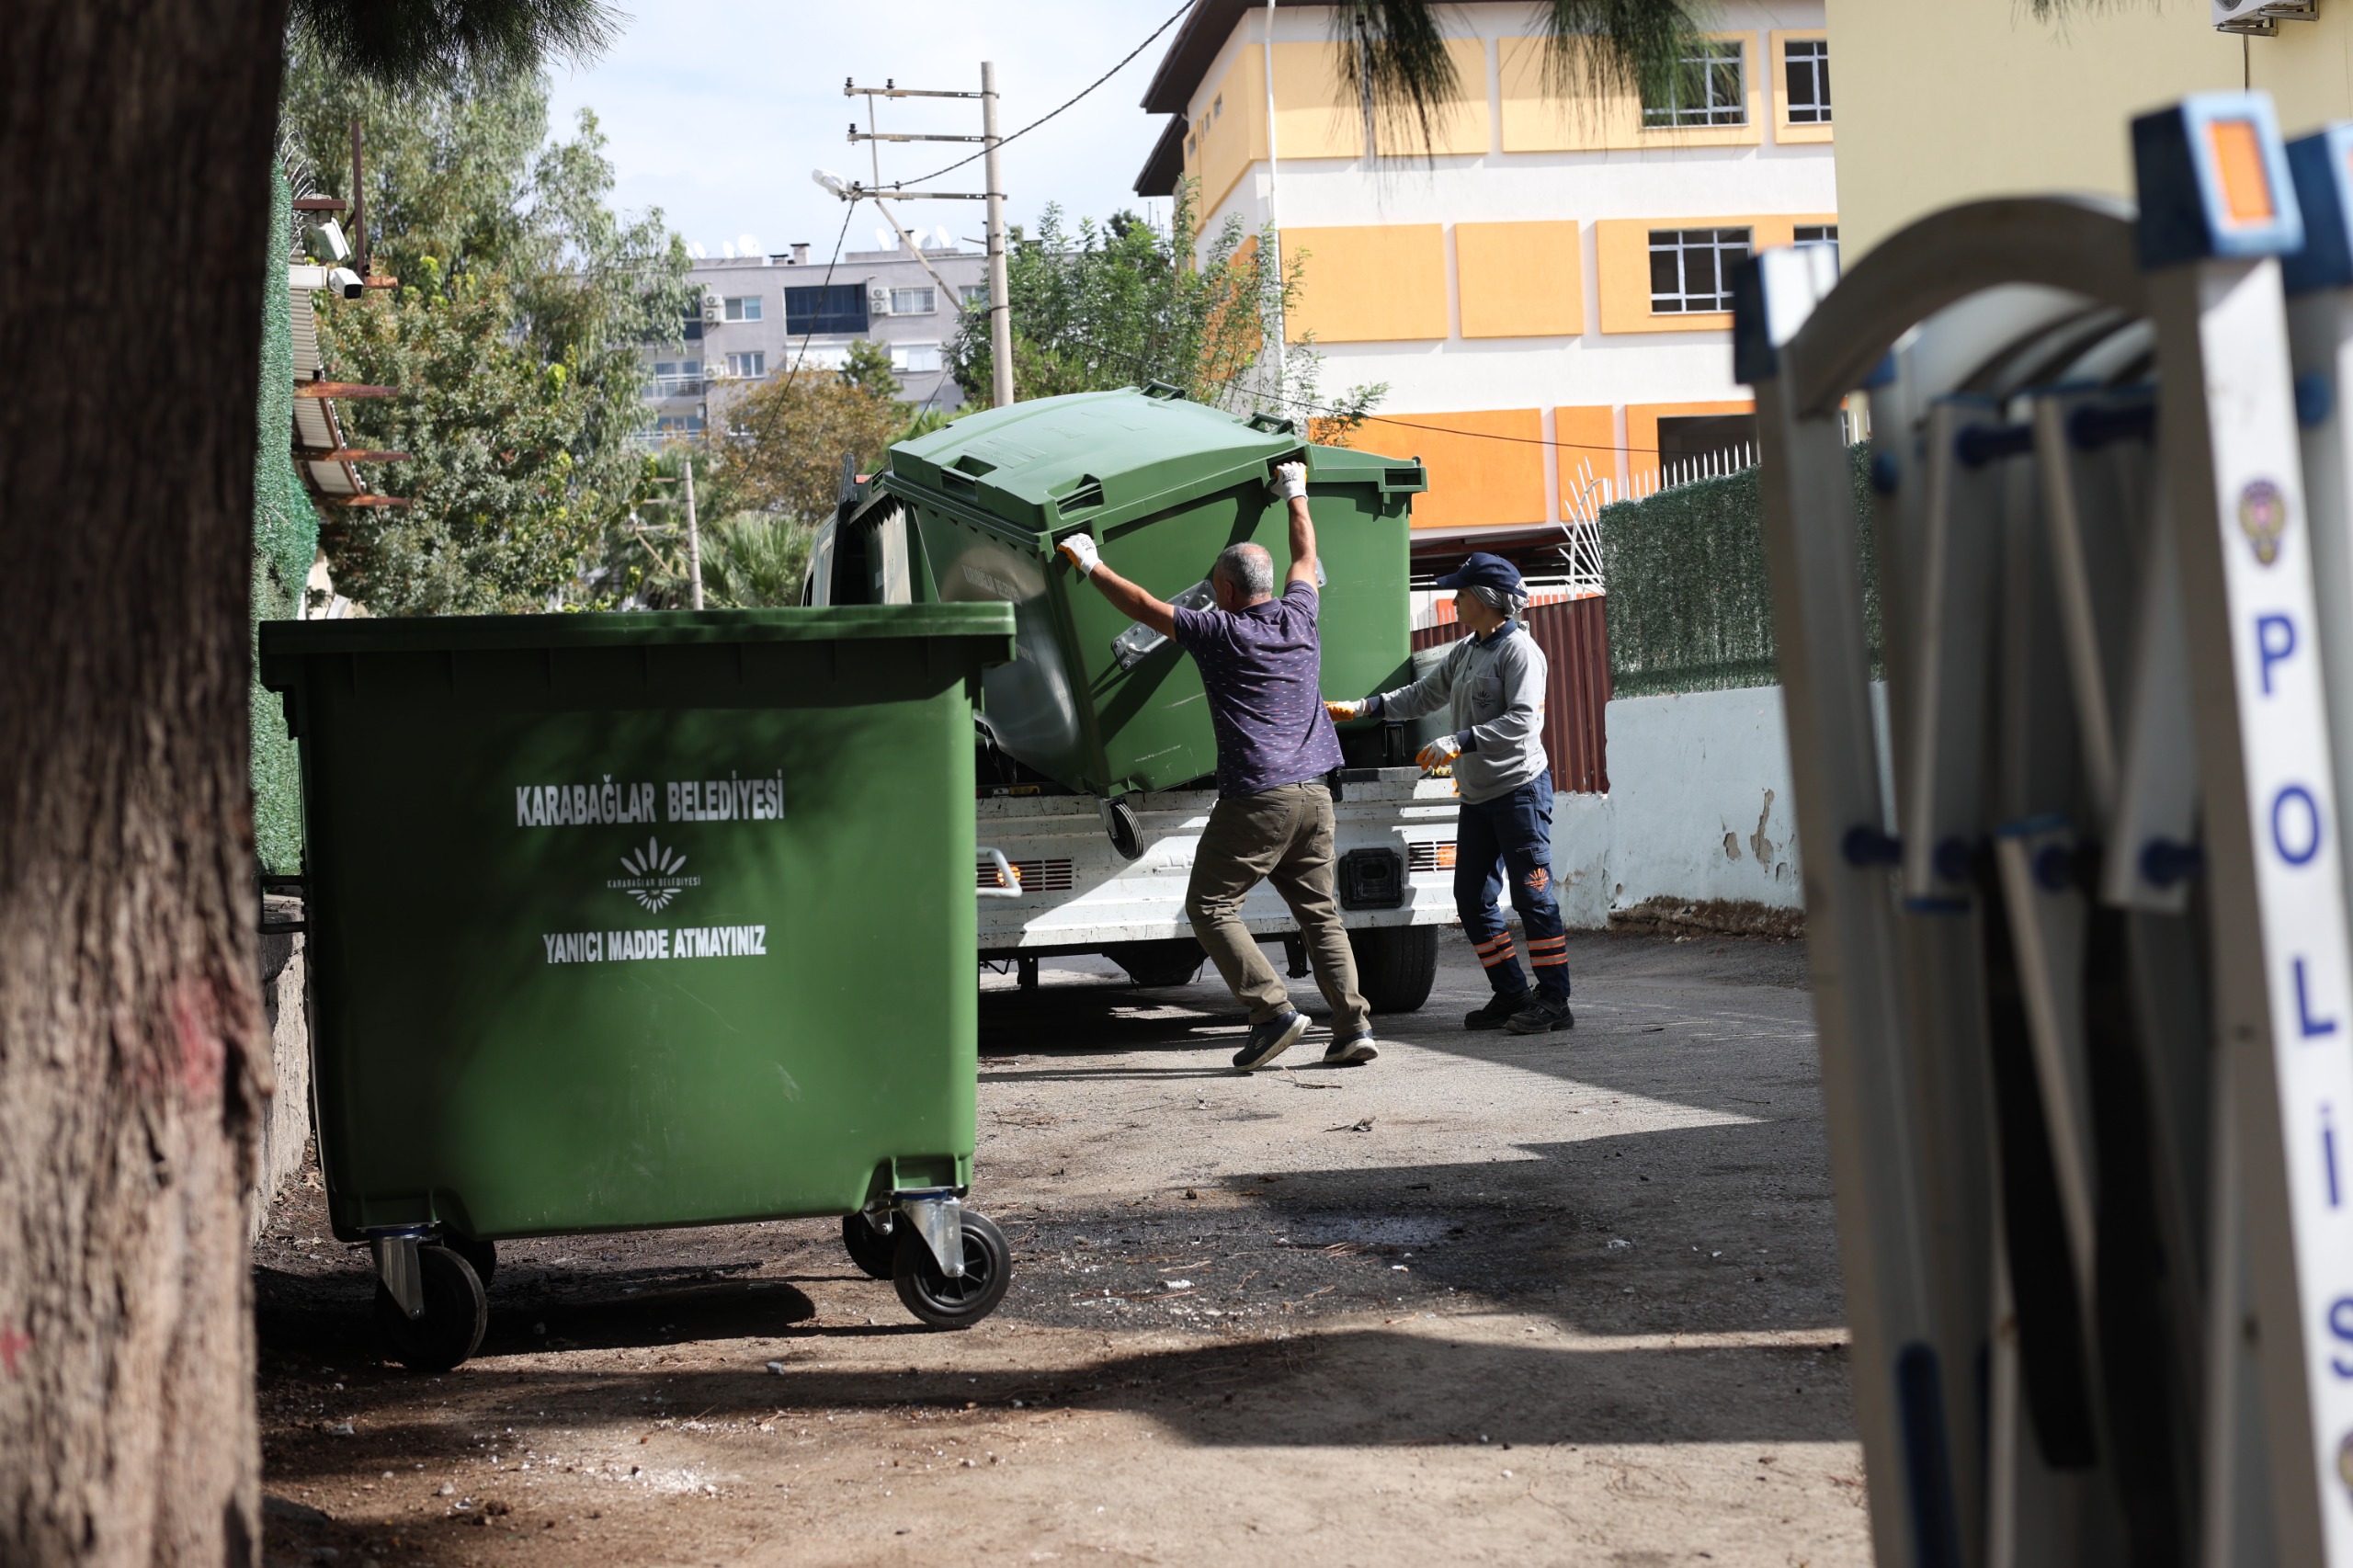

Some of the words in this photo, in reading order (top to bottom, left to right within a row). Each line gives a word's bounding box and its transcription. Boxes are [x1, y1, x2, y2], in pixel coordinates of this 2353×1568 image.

[516, 774, 656, 826] KARABAĞLAR
[666, 769, 784, 821] BELEDİYESİ
[542, 932, 603, 963] YANICI
[608, 929, 669, 961] MADDE
[673, 925, 767, 959] ATMAYINIZ
